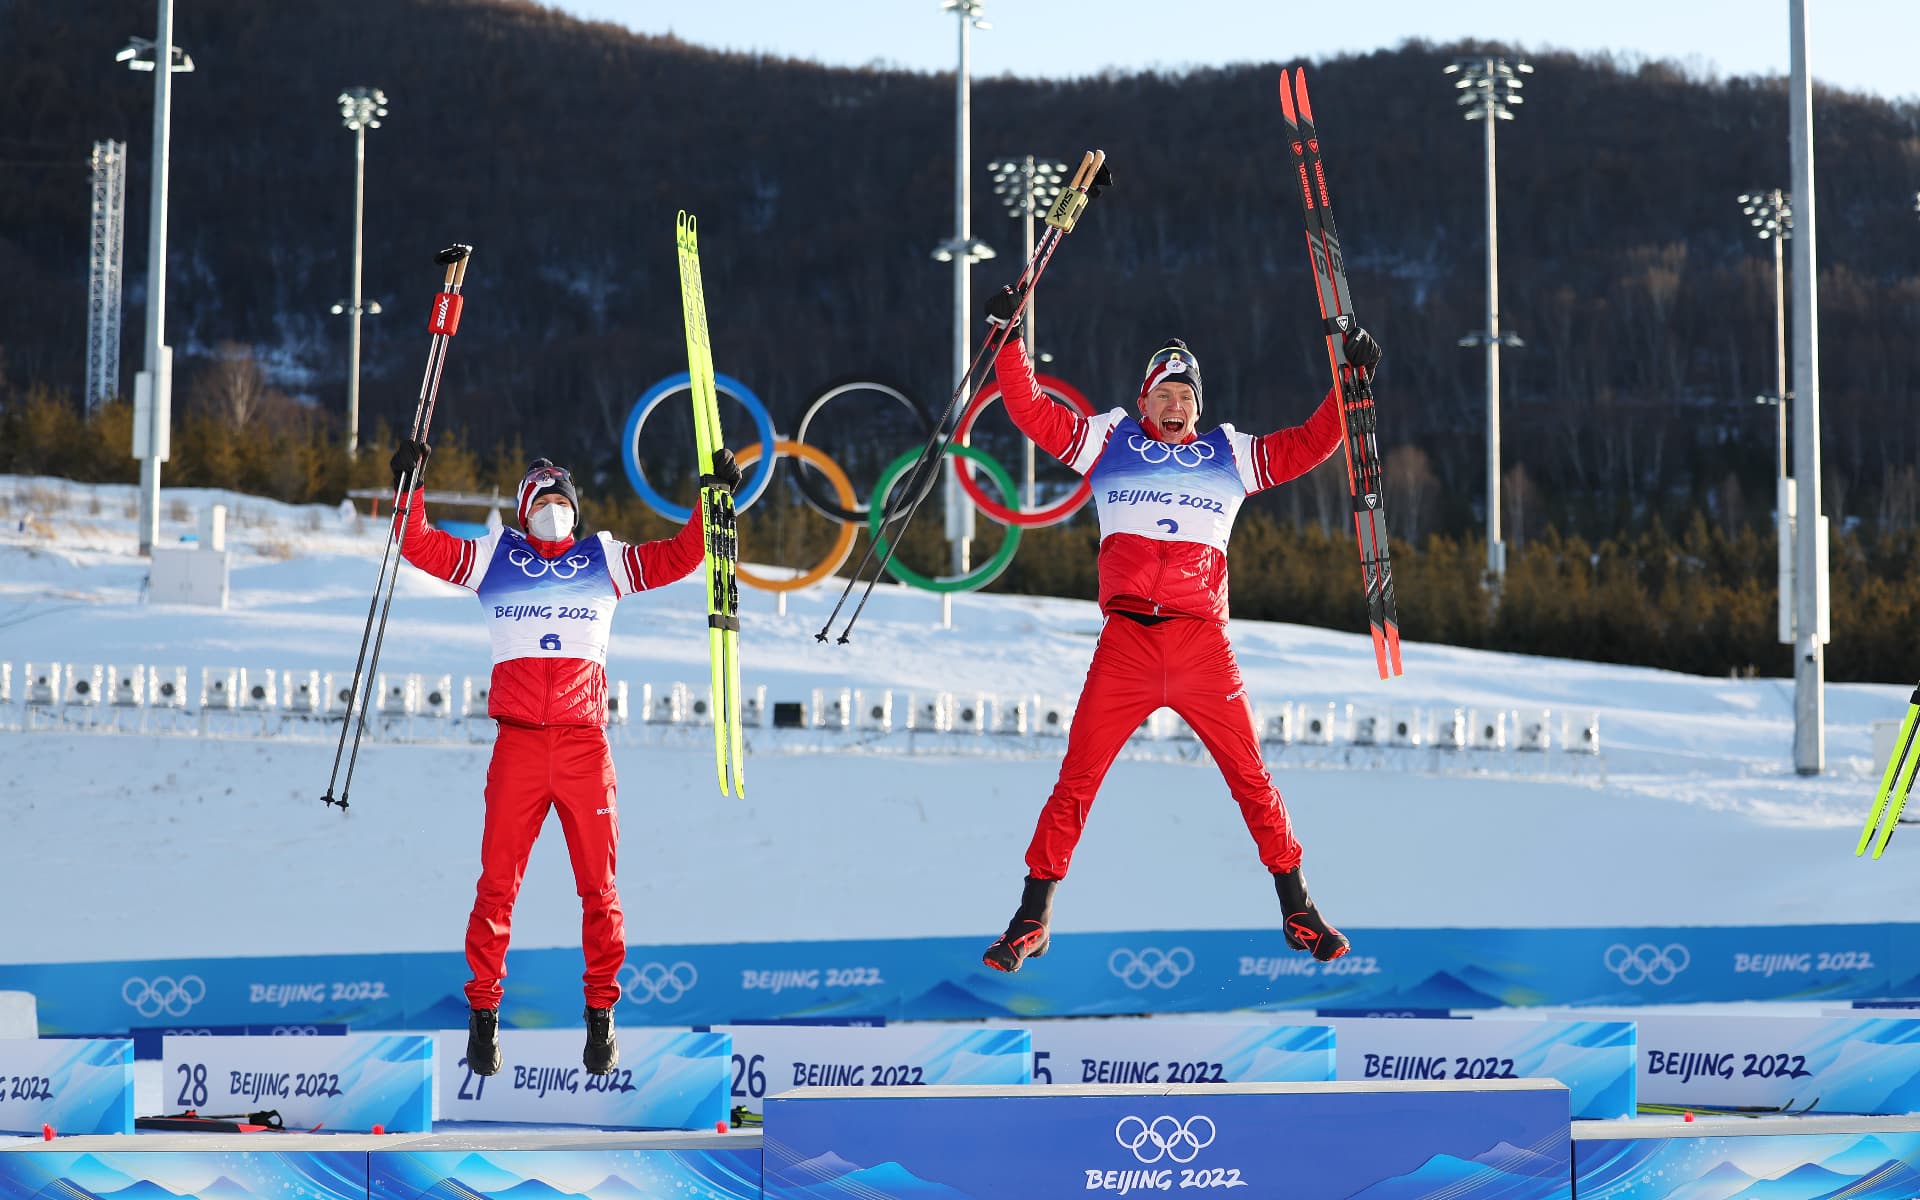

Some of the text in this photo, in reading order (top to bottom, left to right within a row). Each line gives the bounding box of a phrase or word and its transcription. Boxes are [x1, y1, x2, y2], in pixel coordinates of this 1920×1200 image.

[1299, 162, 1314, 210] ROSSIGNOL
[1107, 489, 1224, 514] BEIJING 2022
[494, 605, 600, 622] BEIJING 2022
[539, 633, 562, 651] 6
[1239, 956, 1382, 982] BEIJING 2022
[1733, 951, 1875, 977] BEIJING 2022
[249, 981, 389, 1008] BEIJING 2022
[741, 967, 886, 995] BEIJING 2022
[731, 1053, 928, 1098] 26 BEIJING 2022
[1081, 1058, 1160, 1084] BEIJING
[1166, 1061, 1228, 1084] 2022
[1364, 1053, 1520, 1081] BEIJING 2022
[1648, 1050, 1813, 1084] BEIJING 2022
[10, 1076, 54, 1101] 2022
[177, 1063, 343, 1107] 28 BEIJING 2022
[513, 1065, 579, 1099] BEIJING
[584, 1068, 637, 1093] 2022
[1084, 1168, 1249, 1196] BEIJING 2022
